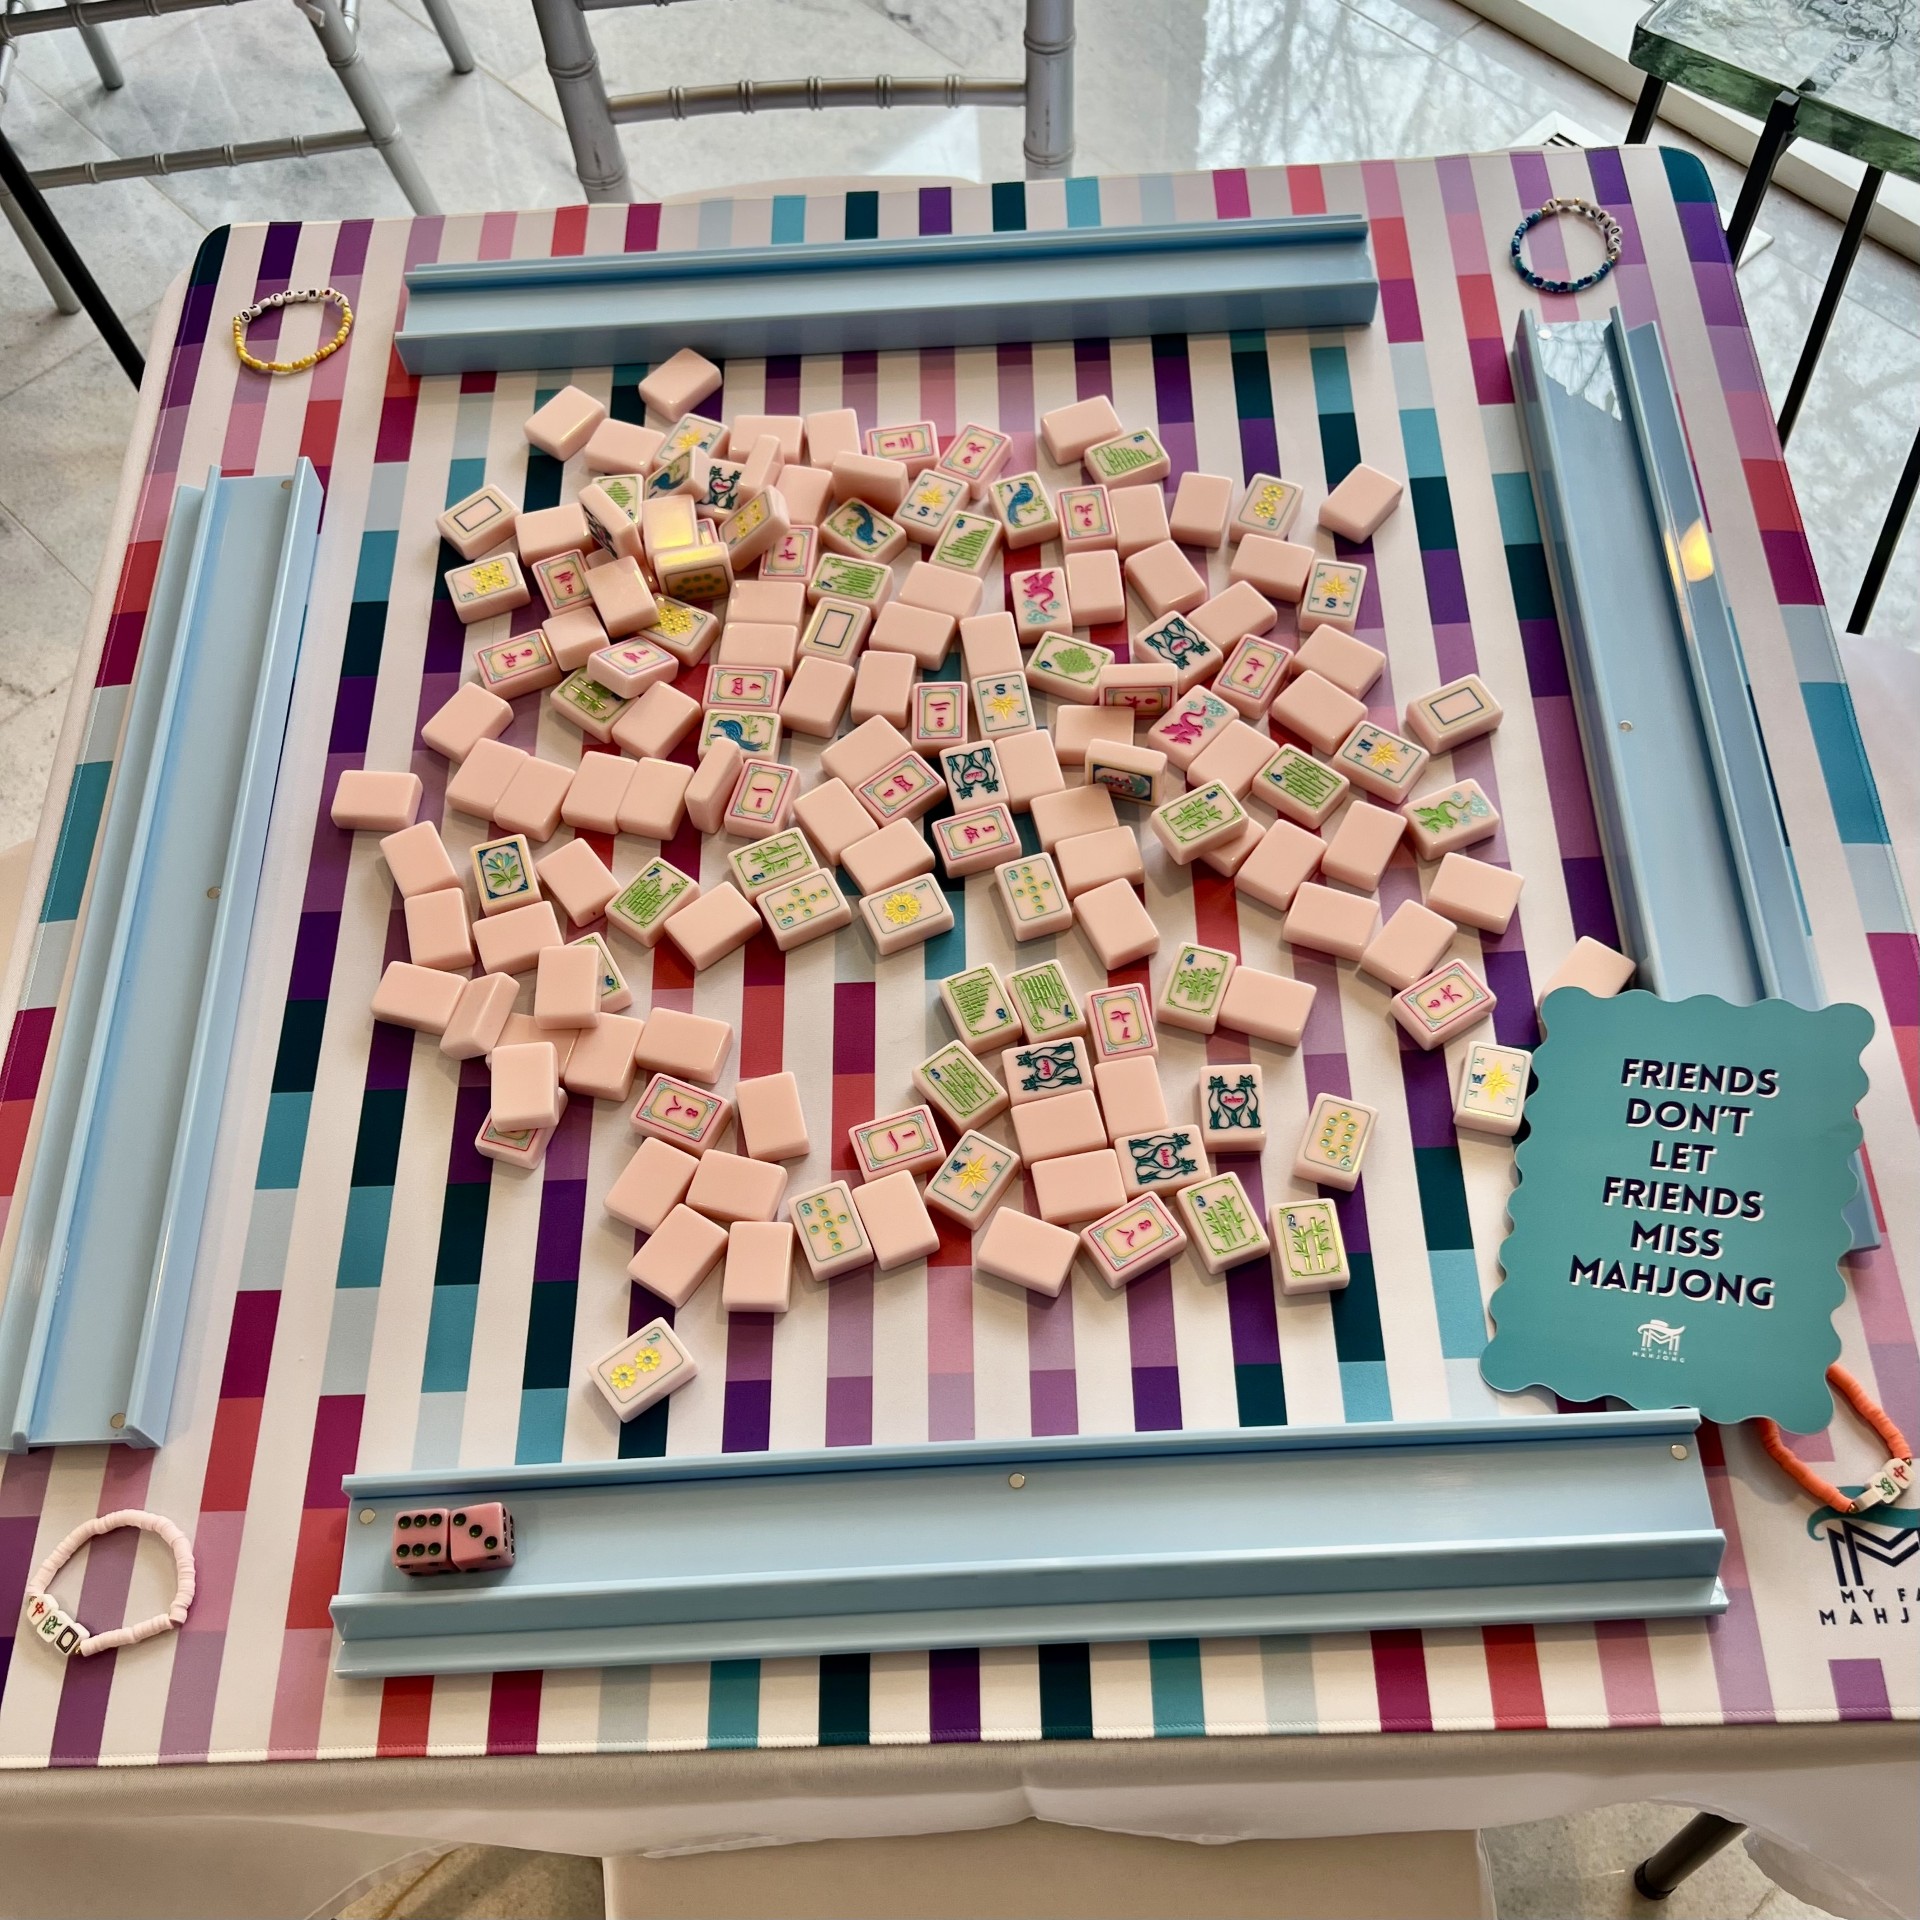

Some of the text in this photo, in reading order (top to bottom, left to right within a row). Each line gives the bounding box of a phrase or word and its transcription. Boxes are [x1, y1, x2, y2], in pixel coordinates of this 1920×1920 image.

[917, 506, 930, 517] S
[1325, 597, 1337, 608] S
[994, 684, 1006, 695] S
[1357, 738, 1374, 752] N
[1043, 1058, 1052, 1076] Joker
[1472, 1073, 1486, 1084] W
[1620, 1058, 1780, 1098] FRIENDS
[1222, 1095, 1244, 1104] Joker
[1626, 1098, 1754, 1136] DON'T
[1160, 1147, 1170, 1168] Joker
[1650, 1140, 1717, 1174] LET
[1602, 1176, 1764, 1222] FRIENDS
[1630, 1220, 1723, 1260] MISS
[1569, 1254, 1776, 1310] MAHJONG
[1632, 1351, 1684, 1362] MAHJONG
[1840, 1588, 1874, 1604] MY
[1818, 1607, 1910, 1626] MAHJ
